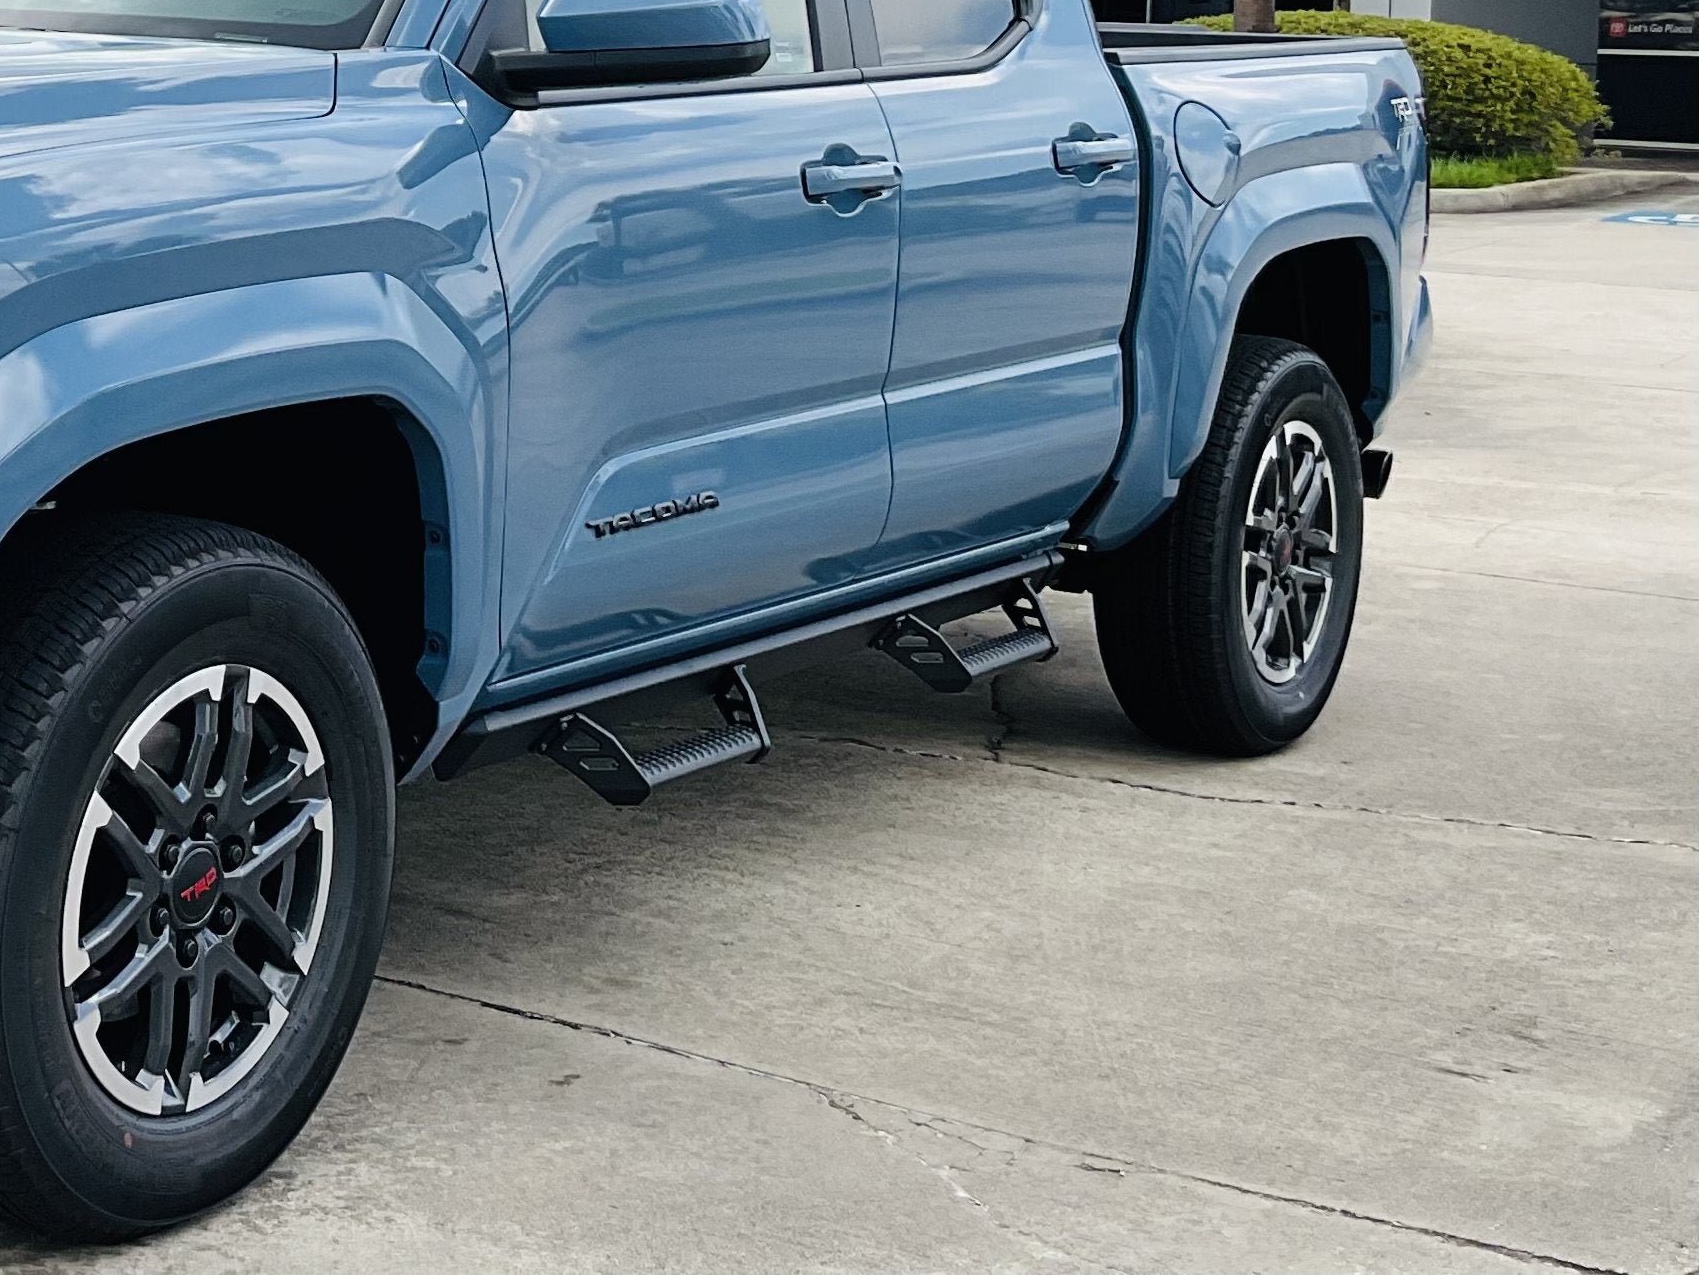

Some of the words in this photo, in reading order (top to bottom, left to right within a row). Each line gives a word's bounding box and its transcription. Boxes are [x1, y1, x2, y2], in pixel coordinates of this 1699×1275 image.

[1650, 24, 1663, 33] Go
[585, 490, 720, 539] TACOMA
[180, 866, 217, 902] TRD
